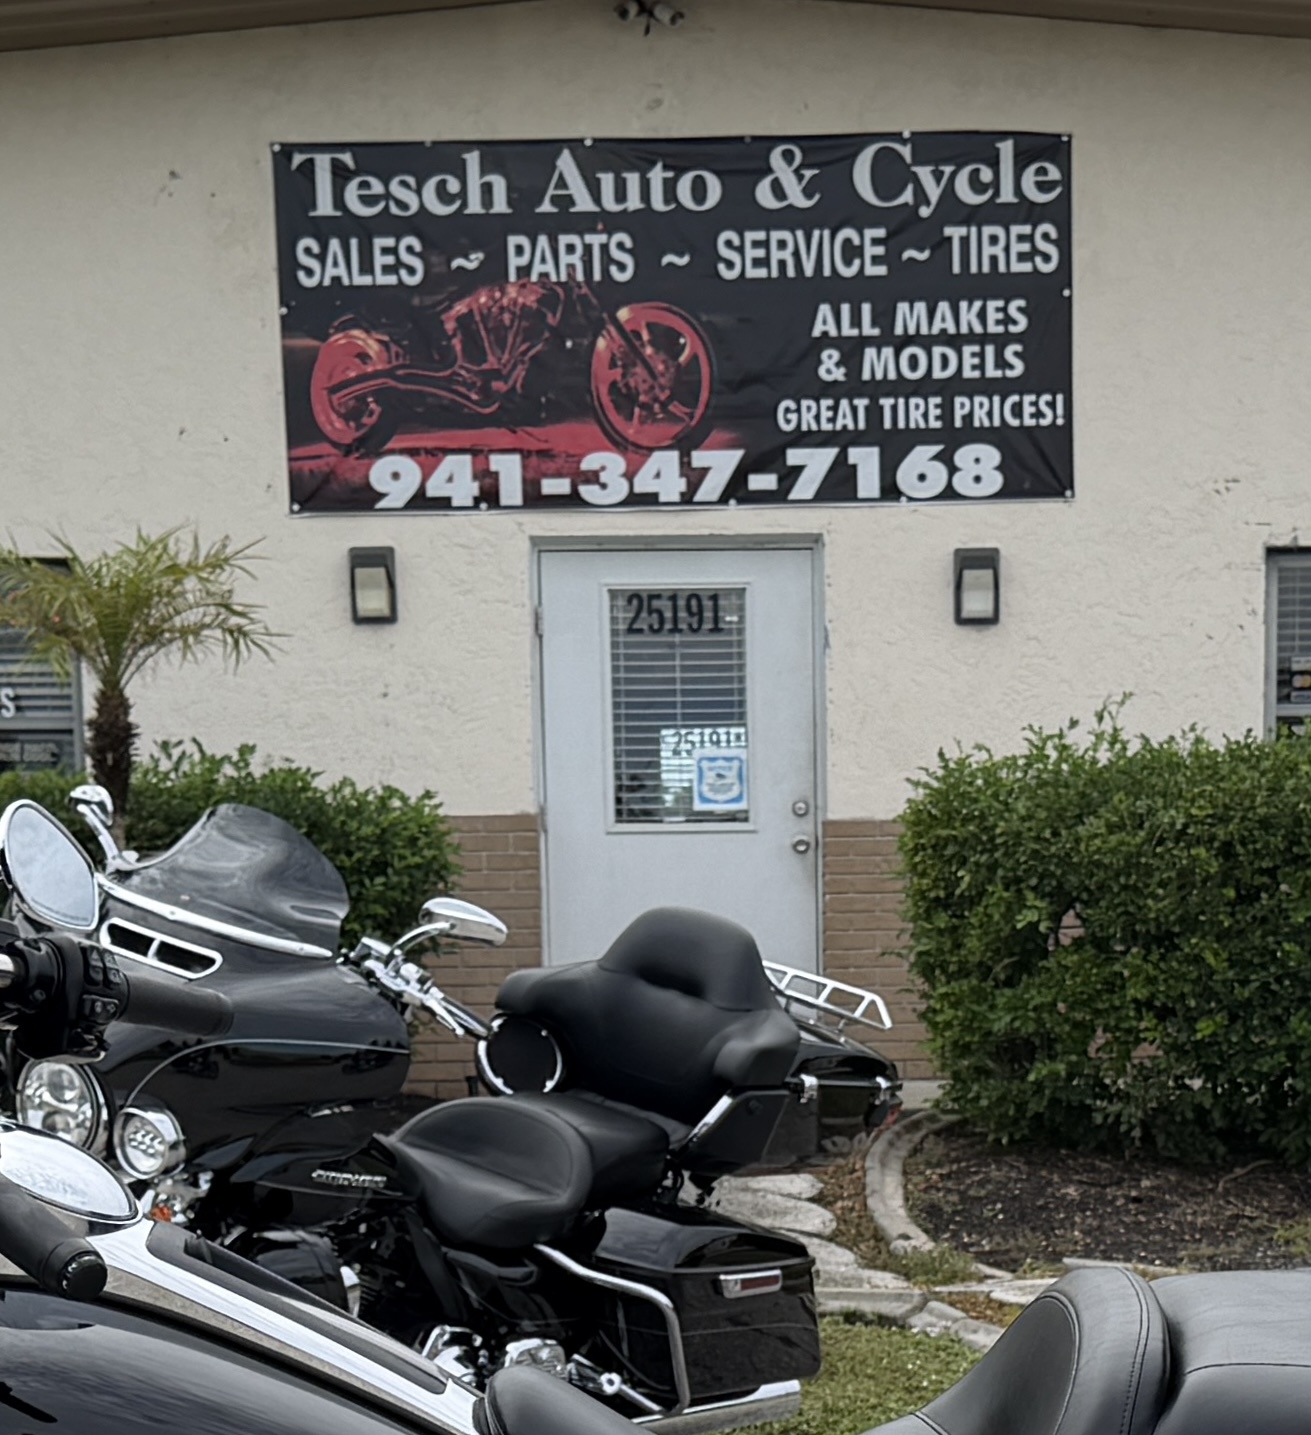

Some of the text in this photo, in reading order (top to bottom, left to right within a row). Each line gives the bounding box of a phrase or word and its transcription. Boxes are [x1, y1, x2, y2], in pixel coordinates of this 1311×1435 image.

[291, 138, 1063, 219] Tesch Auto & Cycle
[295, 235, 425, 288] SALES
[506, 231, 635, 284] PARTS
[716, 227, 888, 280] SERVICE
[943, 222, 1060, 275] TIRES
[811, 298, 1029, 338] ALL MAKES
[817, 343, 1026, 382] & MODELS
[776, 393, 1066, 432] GREAT TIRE PRICES!
[368, 442, 1005, 509] 941-347-7168
[626, 593, 724, 634] 25191
